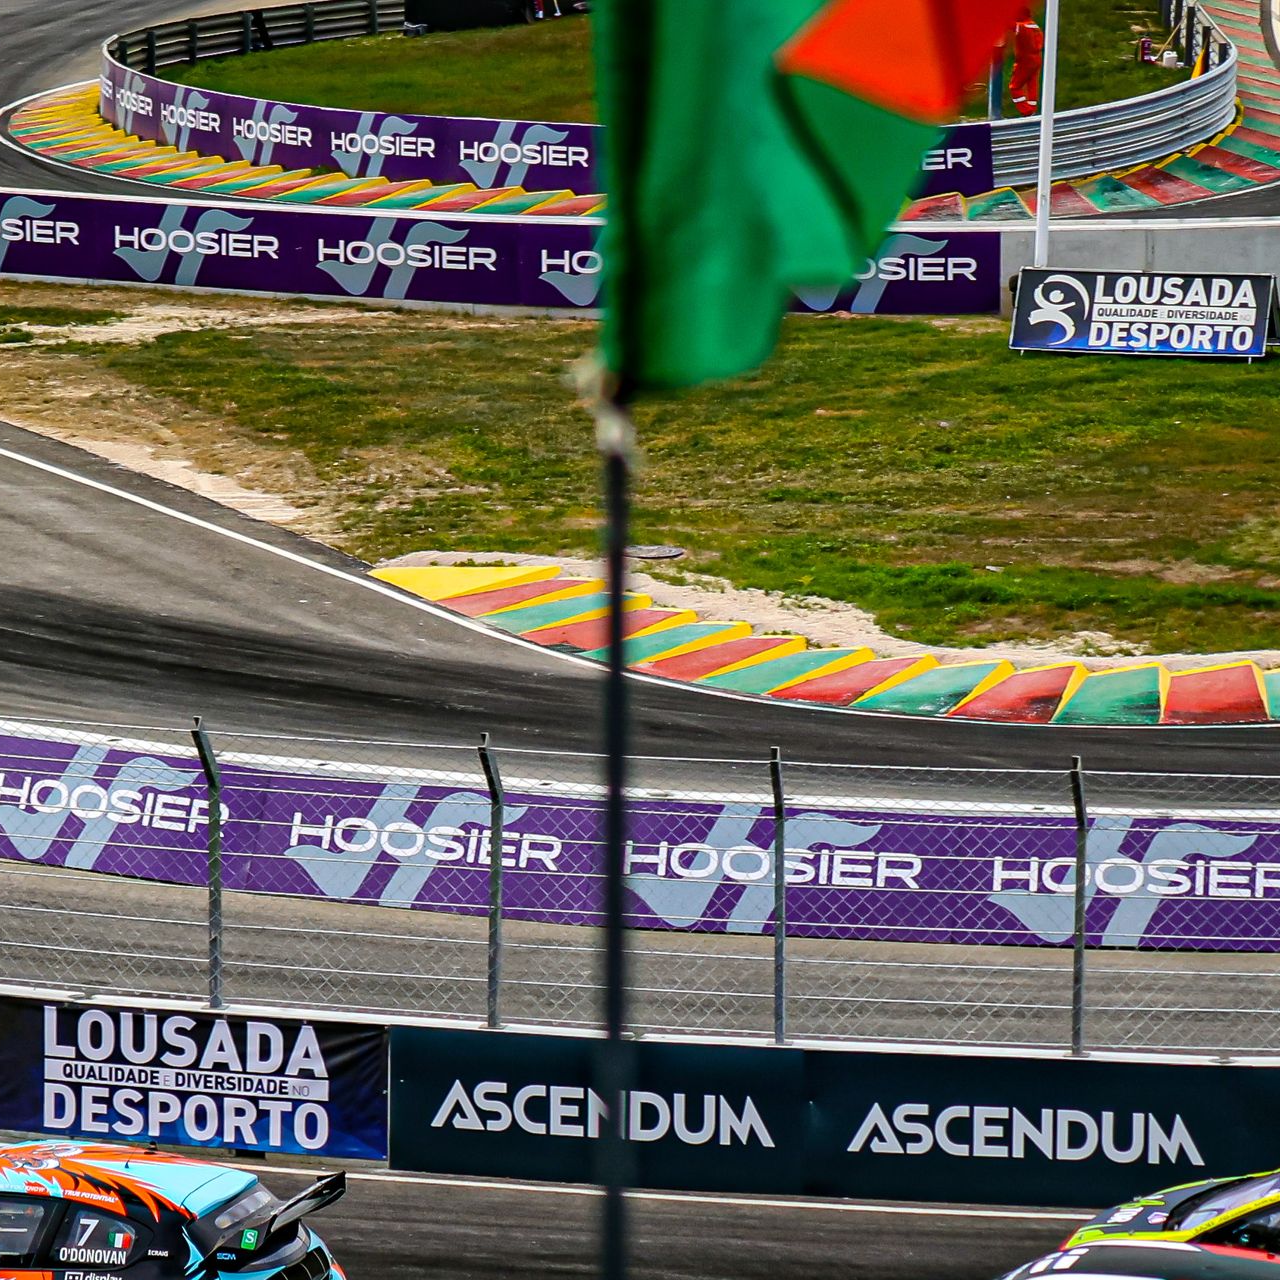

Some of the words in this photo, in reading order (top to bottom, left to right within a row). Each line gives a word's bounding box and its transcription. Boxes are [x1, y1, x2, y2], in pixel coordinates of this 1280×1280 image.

[160, 102, 220, 133] HOOSIER
[233, 117, 312, 148] HOOSIER
[331, 131, 435, 158] HOOSIER
[459, 140, 589, 168] HOOSIER
[114, 225, 280, 259] HOOSIER
[317, 238, 497, 271] HOOSIER
[1095, 275, 1256, 307] LOUSADA
[1097, 308, 1158, 318] QUALIDADE
[1167, 310, 1239, 320] DIVERSIDADE
[1089, 322, 1254, 351] DESPORTO
[289, 810, 563, 872] HOOSIER
[623, 838, 922, 890] HOOSIER
[42, 1004, 328, 1079] LOUSADA
[62, 1062, 162, 1087] QUALIDADE
[173, 1071, 290, 1096] DIVERSIDADE
[42, 1081, 330, 1151] DESPORTO
[847, 1102, 1205, 1167] ASCENDUM
[77, 1217, 100, 1248] 7
[244, 1230, 256, 1244] S
[59, 1247, 127, 1266] O'DONOVAN
